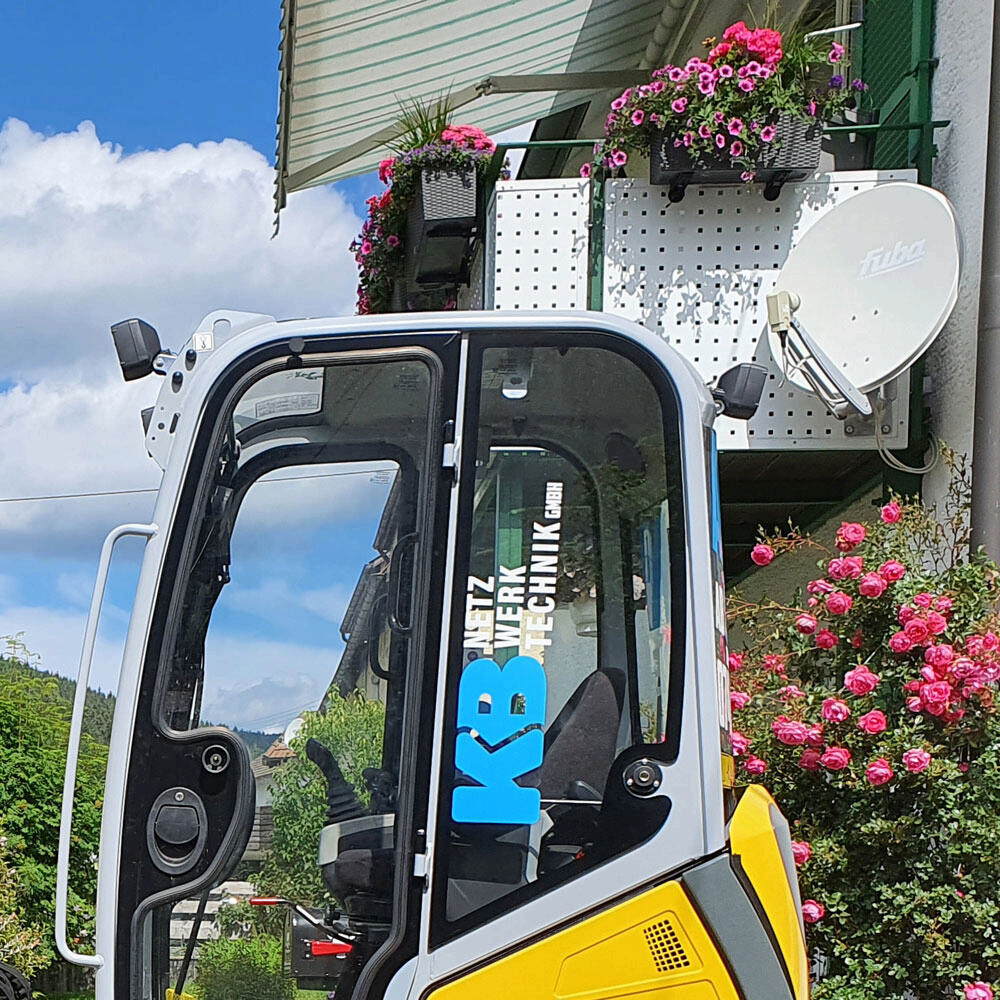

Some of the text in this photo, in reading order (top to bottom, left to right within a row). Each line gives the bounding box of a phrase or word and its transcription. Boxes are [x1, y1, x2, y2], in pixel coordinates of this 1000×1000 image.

[463, 575, 495, 650] NETZ
[494, 565, 528, 650] WERK
[525, 482, 564, 651] TECHNIK GMBH
[451, 655, 548, 825] KB
